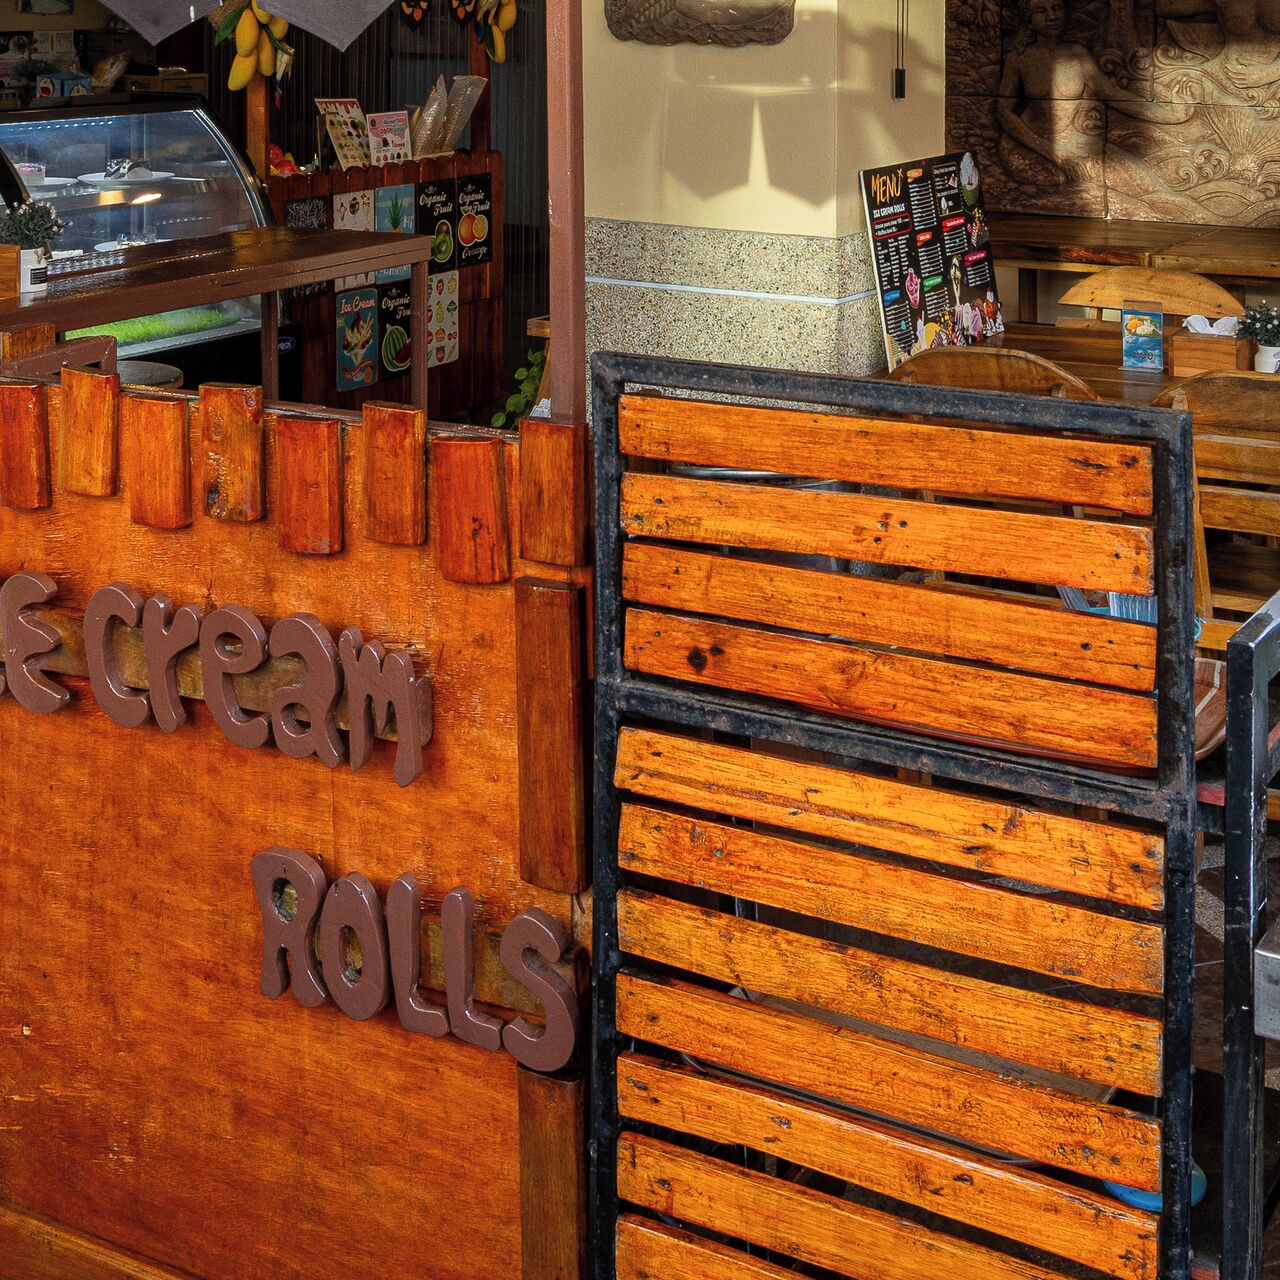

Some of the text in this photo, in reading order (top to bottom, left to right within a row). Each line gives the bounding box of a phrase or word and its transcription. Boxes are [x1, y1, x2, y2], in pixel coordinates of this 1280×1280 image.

[871, 170, 901, 205] MENU
[419, 191, 448, 207] Organic
[459, 189, 485, 205] Organic
[433, 202, 453, 216] Fruit
[340, 295, 376, 313] Ice Cream
[381, 293, 411, 310] Organic
[250, 845, 580, 1073] ROLLS
